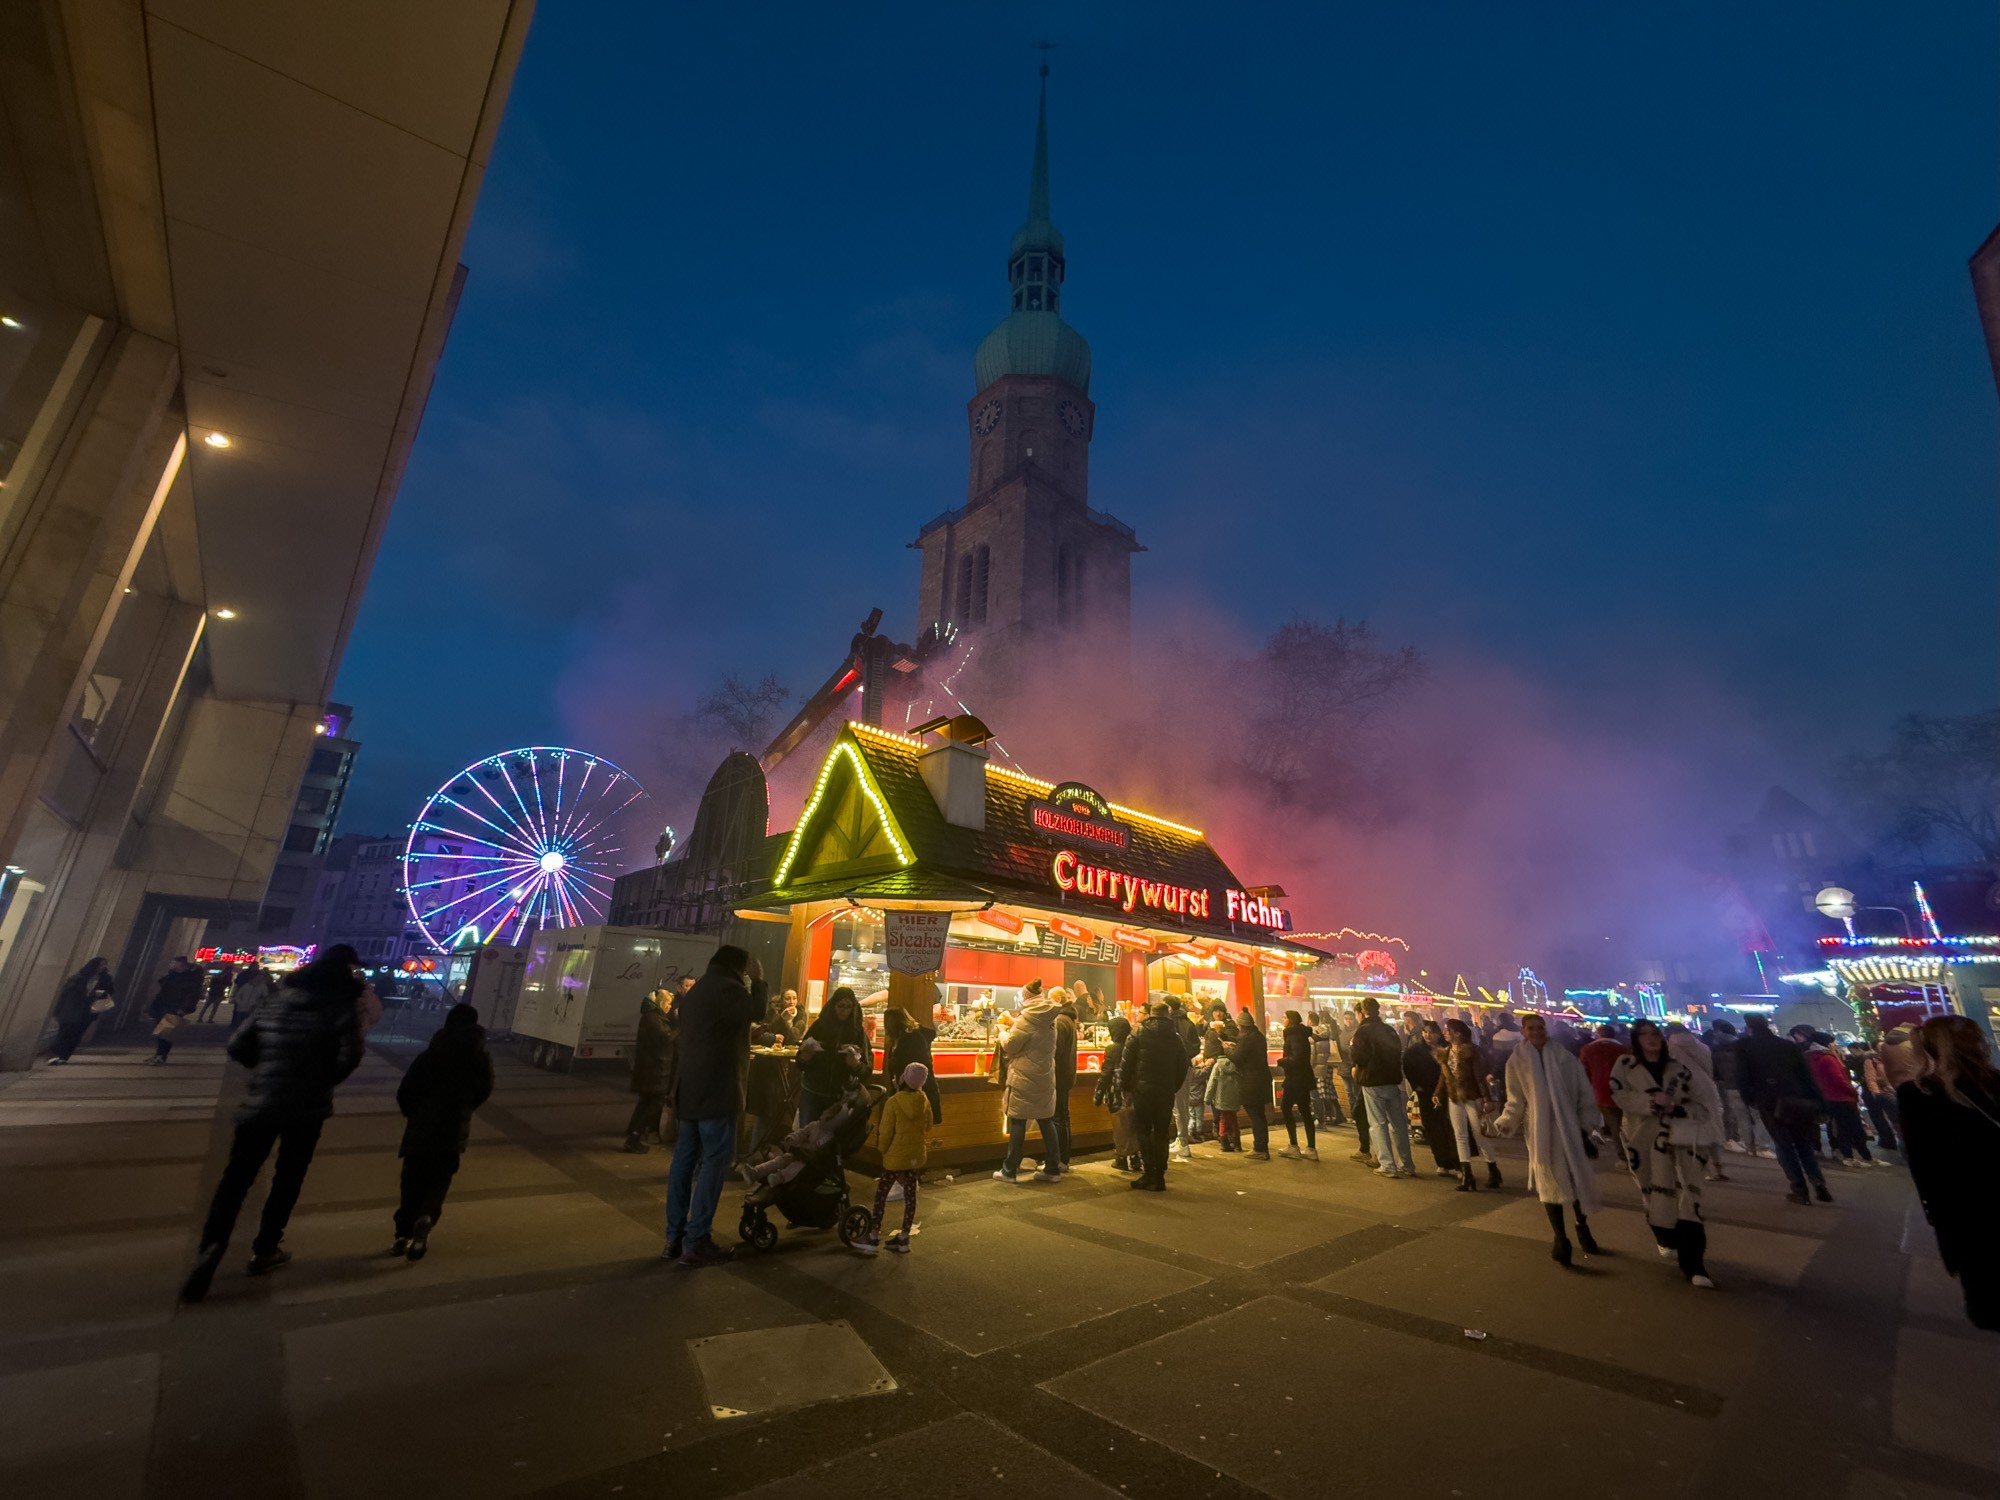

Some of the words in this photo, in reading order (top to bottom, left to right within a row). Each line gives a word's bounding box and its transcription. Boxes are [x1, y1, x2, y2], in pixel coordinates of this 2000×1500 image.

[1034, 808, 1125, 848] HOLZKOHLENGRILL
[1053, 850, 1210, 918] Currywurst
[898, 916, 939, 924] HIER
[889, 931, 942, 949] Steaks
[616, 962, 643, 980] Leo
